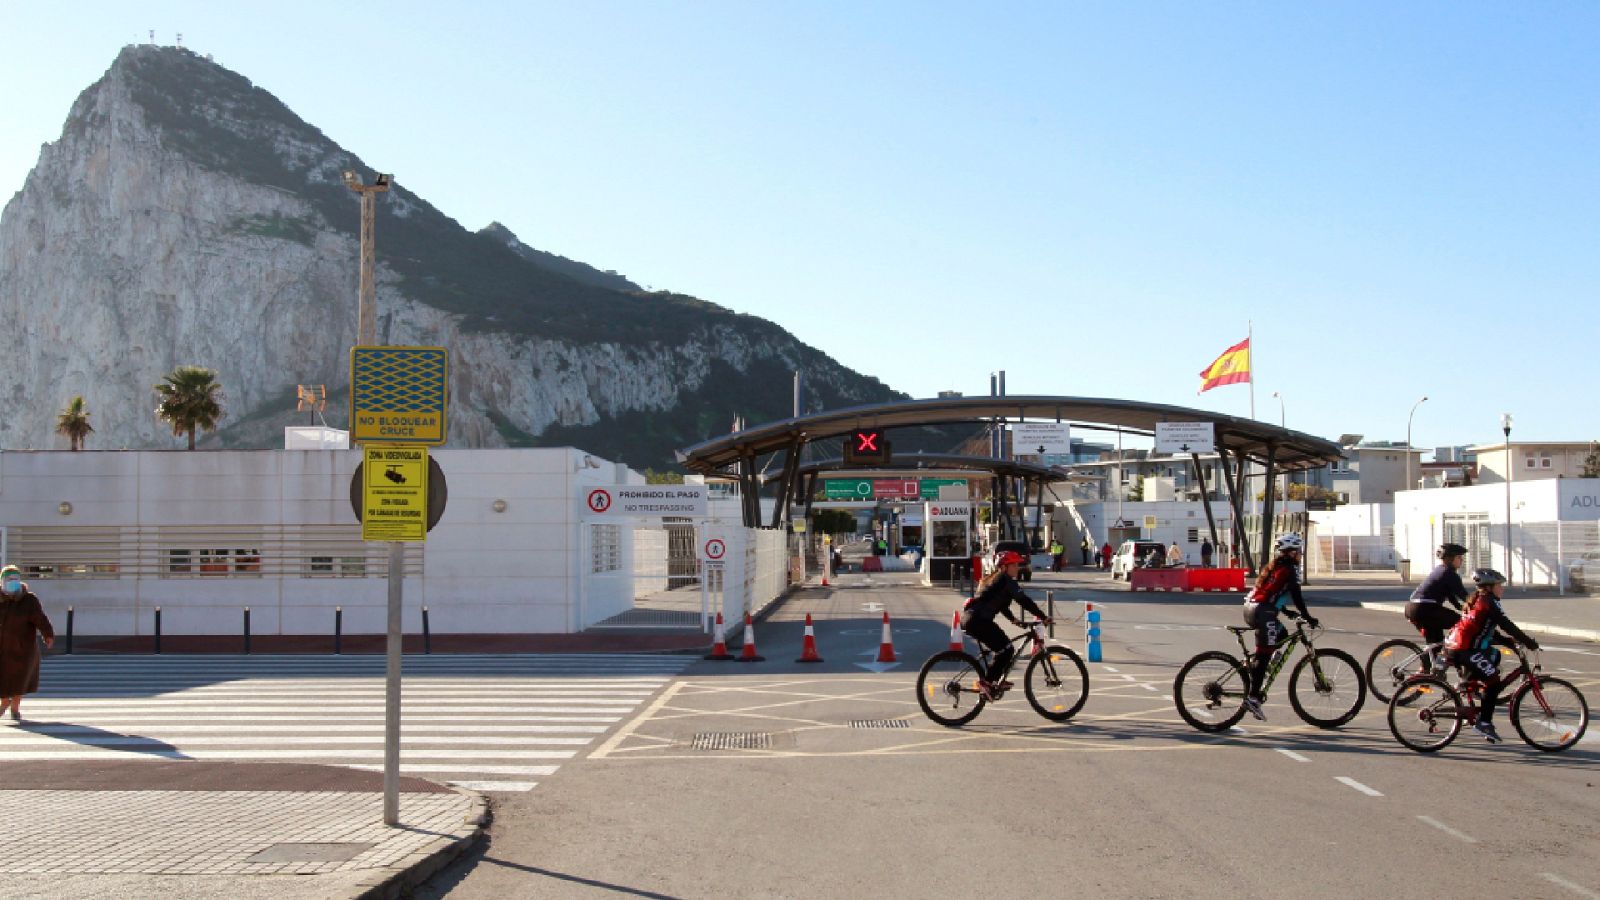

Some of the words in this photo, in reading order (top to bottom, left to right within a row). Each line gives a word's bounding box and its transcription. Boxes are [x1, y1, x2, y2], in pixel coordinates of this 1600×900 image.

[359, 416, 375, 426] NO
[379, 416, 436, 427] BLOQUEAR
[379, 427, 415, 437] CRUCE
[369, 451, 384, 460] ZONA
[677, 491, 700, 499] PASO
[939, 507, 969, 515] ADUANA
